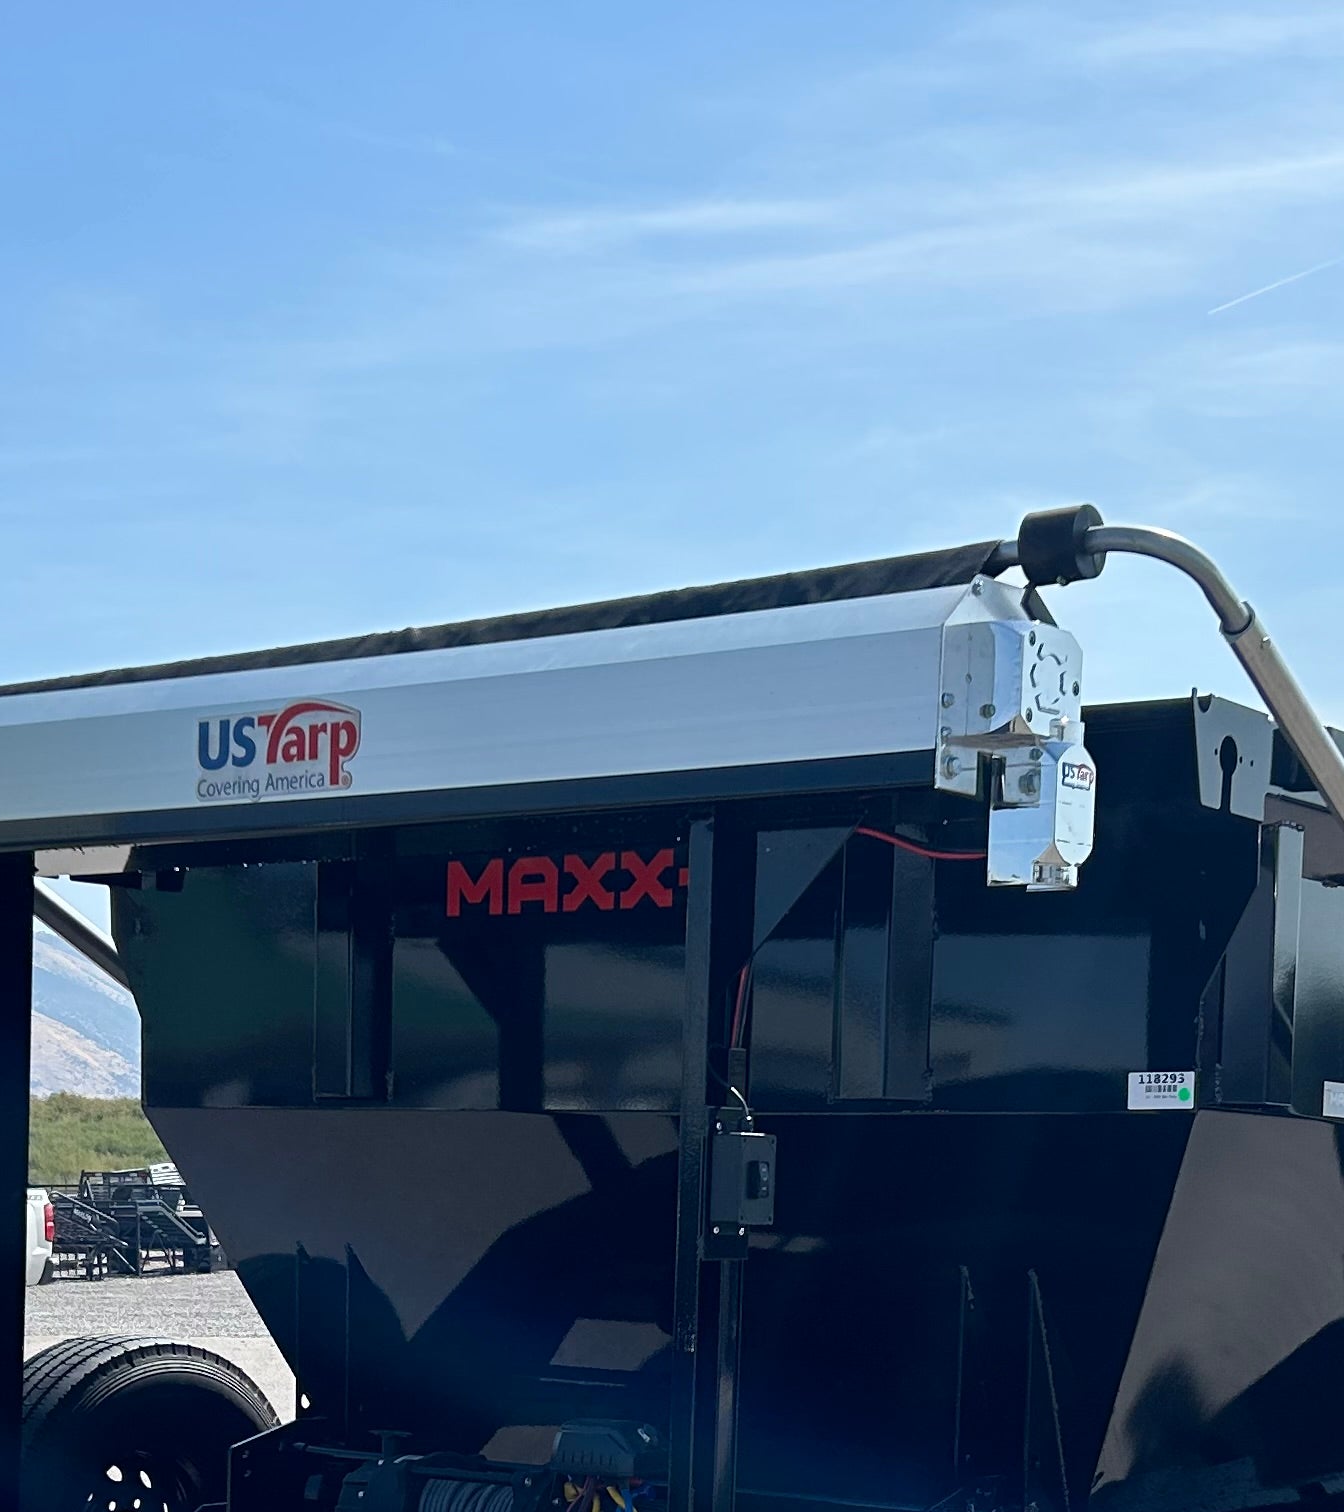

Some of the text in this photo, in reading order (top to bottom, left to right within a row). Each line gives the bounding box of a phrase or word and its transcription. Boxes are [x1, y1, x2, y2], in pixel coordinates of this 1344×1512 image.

[197, 770, 325, 799] Covering America
[1138, 1073, 1185, 1085] 118293
